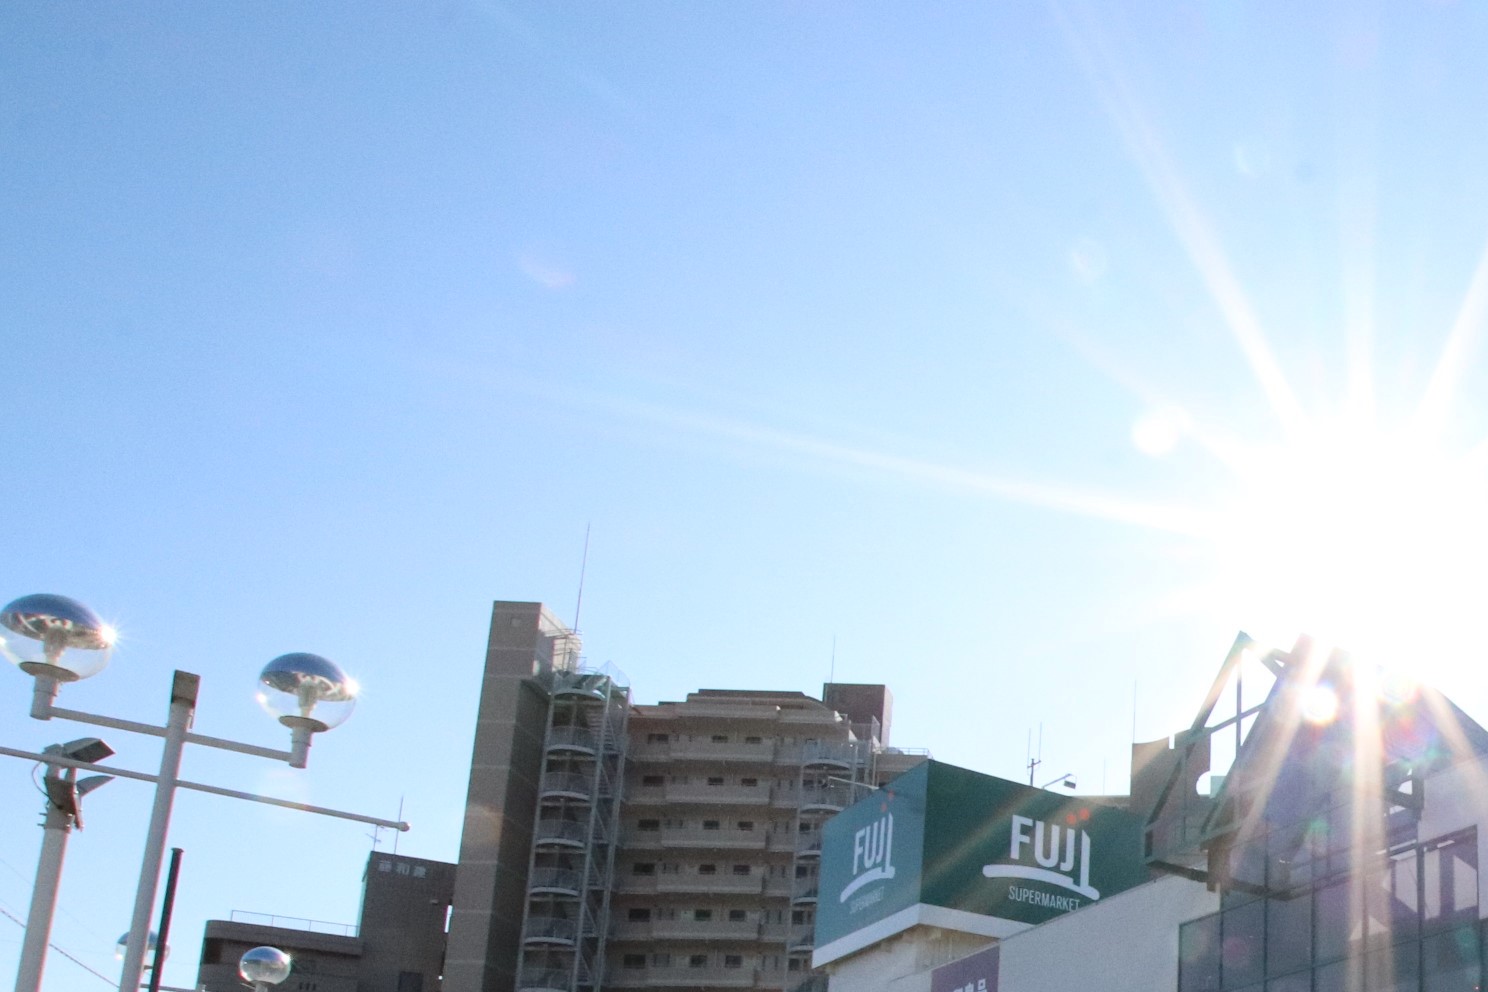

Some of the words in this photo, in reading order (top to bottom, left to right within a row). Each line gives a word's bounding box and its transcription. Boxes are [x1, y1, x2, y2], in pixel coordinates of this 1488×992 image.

[852, 811, 895, 878] FUJI
[1010, 811, 1094, 890] FUJI
[1008, 885, 1081, 911] SUPERMARKET
